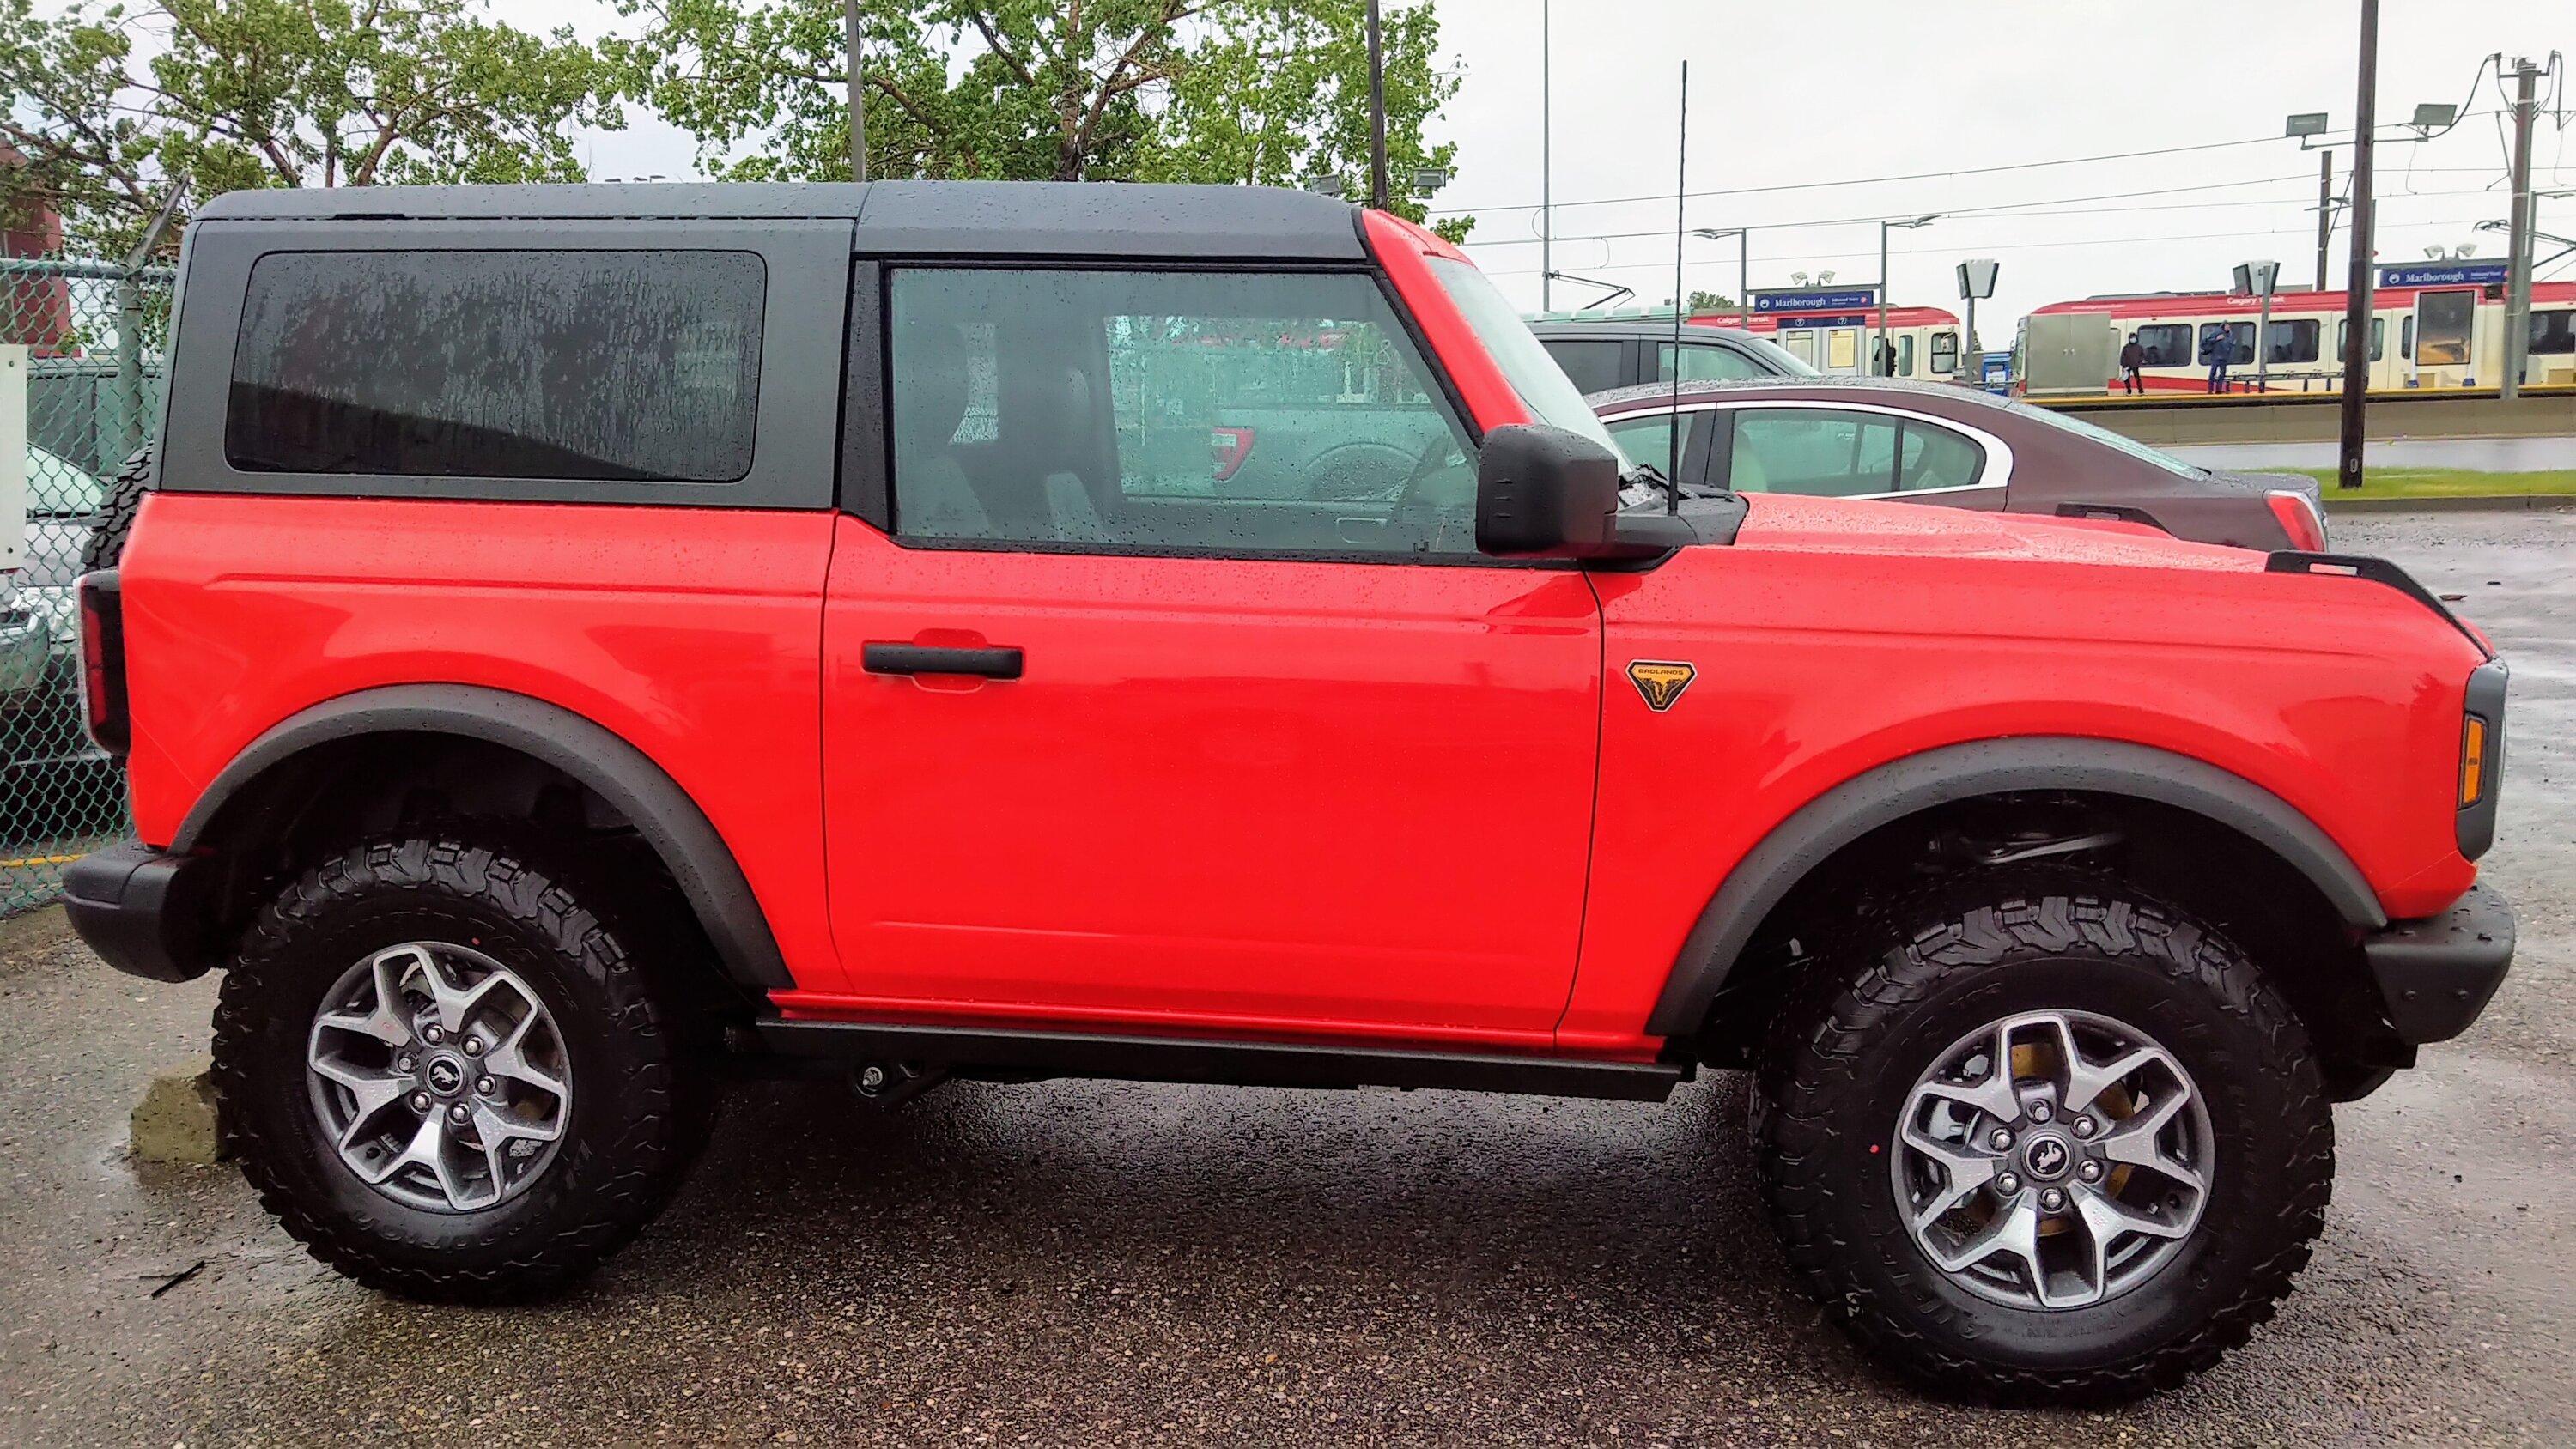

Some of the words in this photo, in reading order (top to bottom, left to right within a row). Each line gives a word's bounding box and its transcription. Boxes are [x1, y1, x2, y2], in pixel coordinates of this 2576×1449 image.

[2405, 271, 2464, 282] Marlborough
[1775, 297, 1826, 307] Marlborough
[2227, 296, 2257, 306] Calgary
